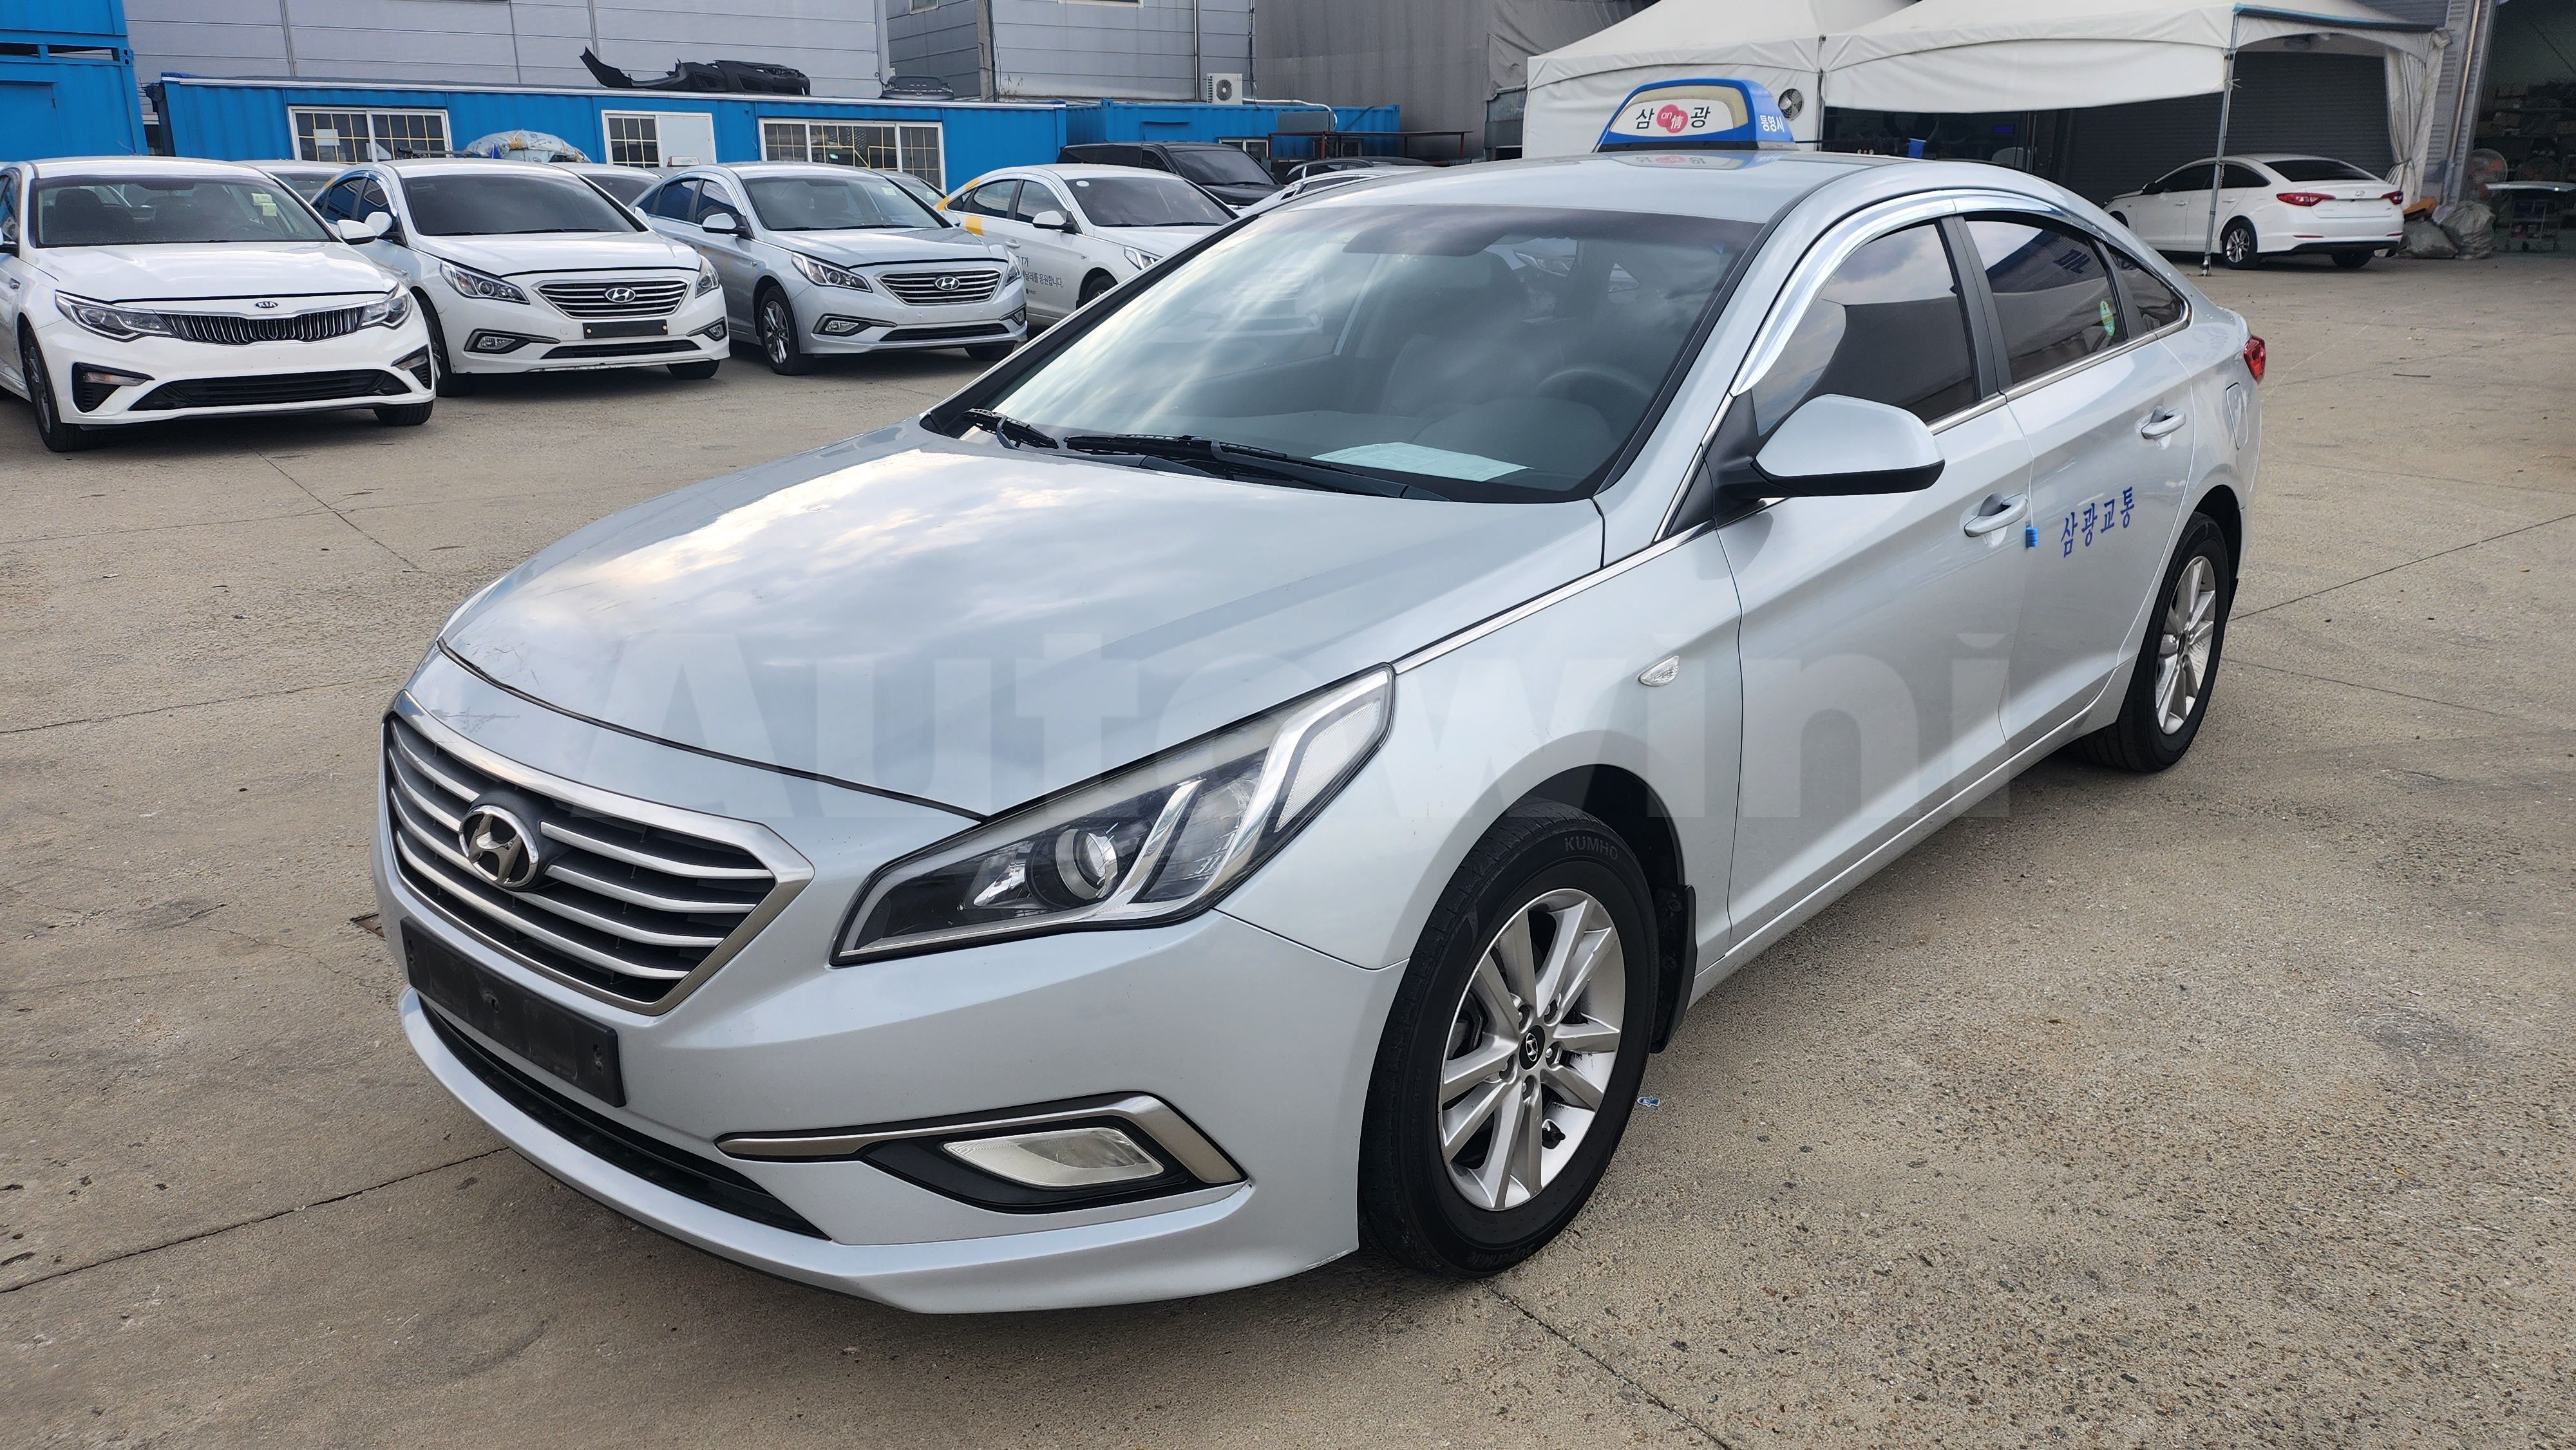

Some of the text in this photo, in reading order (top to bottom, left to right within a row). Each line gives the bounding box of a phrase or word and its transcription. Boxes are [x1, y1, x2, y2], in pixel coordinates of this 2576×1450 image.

[1635, 106, 1711, 129] 삼 광
[1671, 115, 1683, 129] 情
[1759, 115, 1785, 133] 통영시
[2060, 485, 2135, 558] 삼광교통
[1564, 836, 1618, 861] KUMHO
